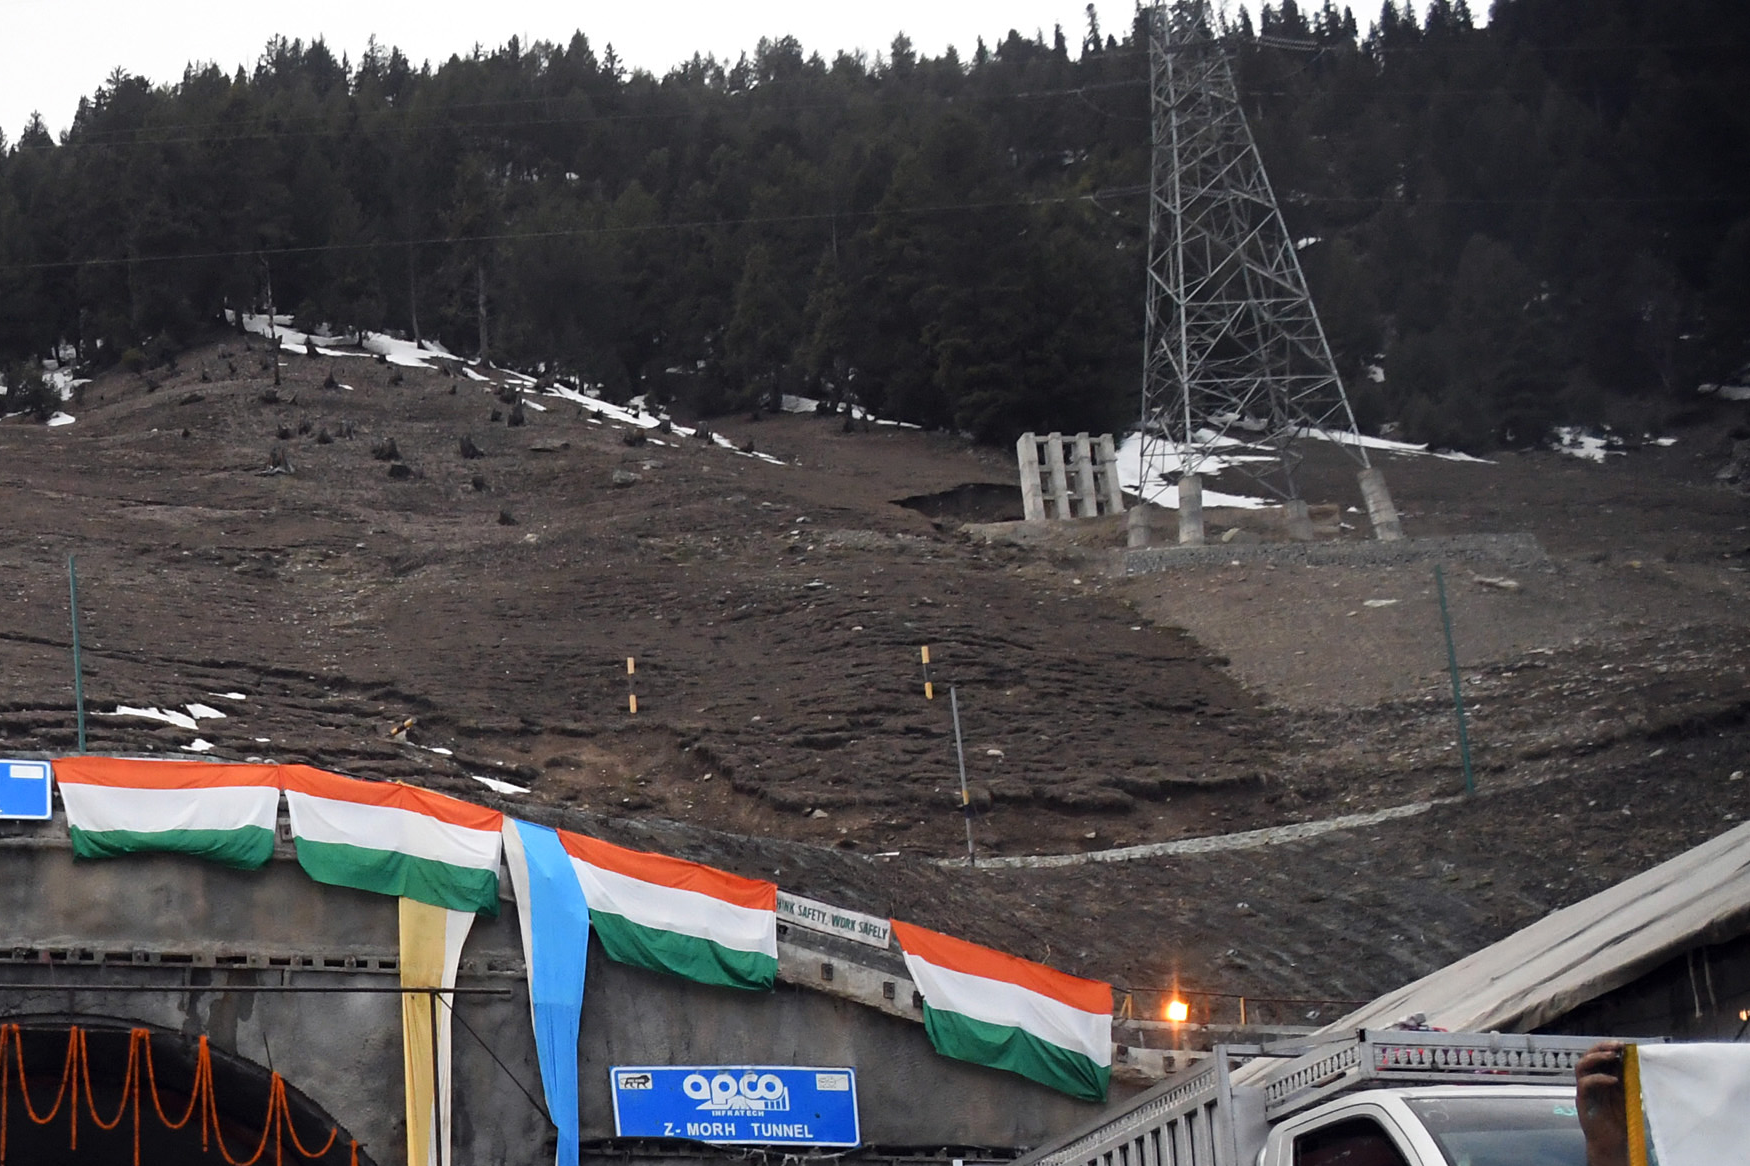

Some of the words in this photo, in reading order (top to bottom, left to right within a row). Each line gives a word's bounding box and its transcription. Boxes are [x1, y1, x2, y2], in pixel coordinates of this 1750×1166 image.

[831, 914, 856, 931] WORK
[858, 922, 888, 940] SAFELY
[682, 1074, 784, 1105] apco
[686, 1122, 736, 1136] MORH
[751, 1123, 814, 1138] TUNNEL
